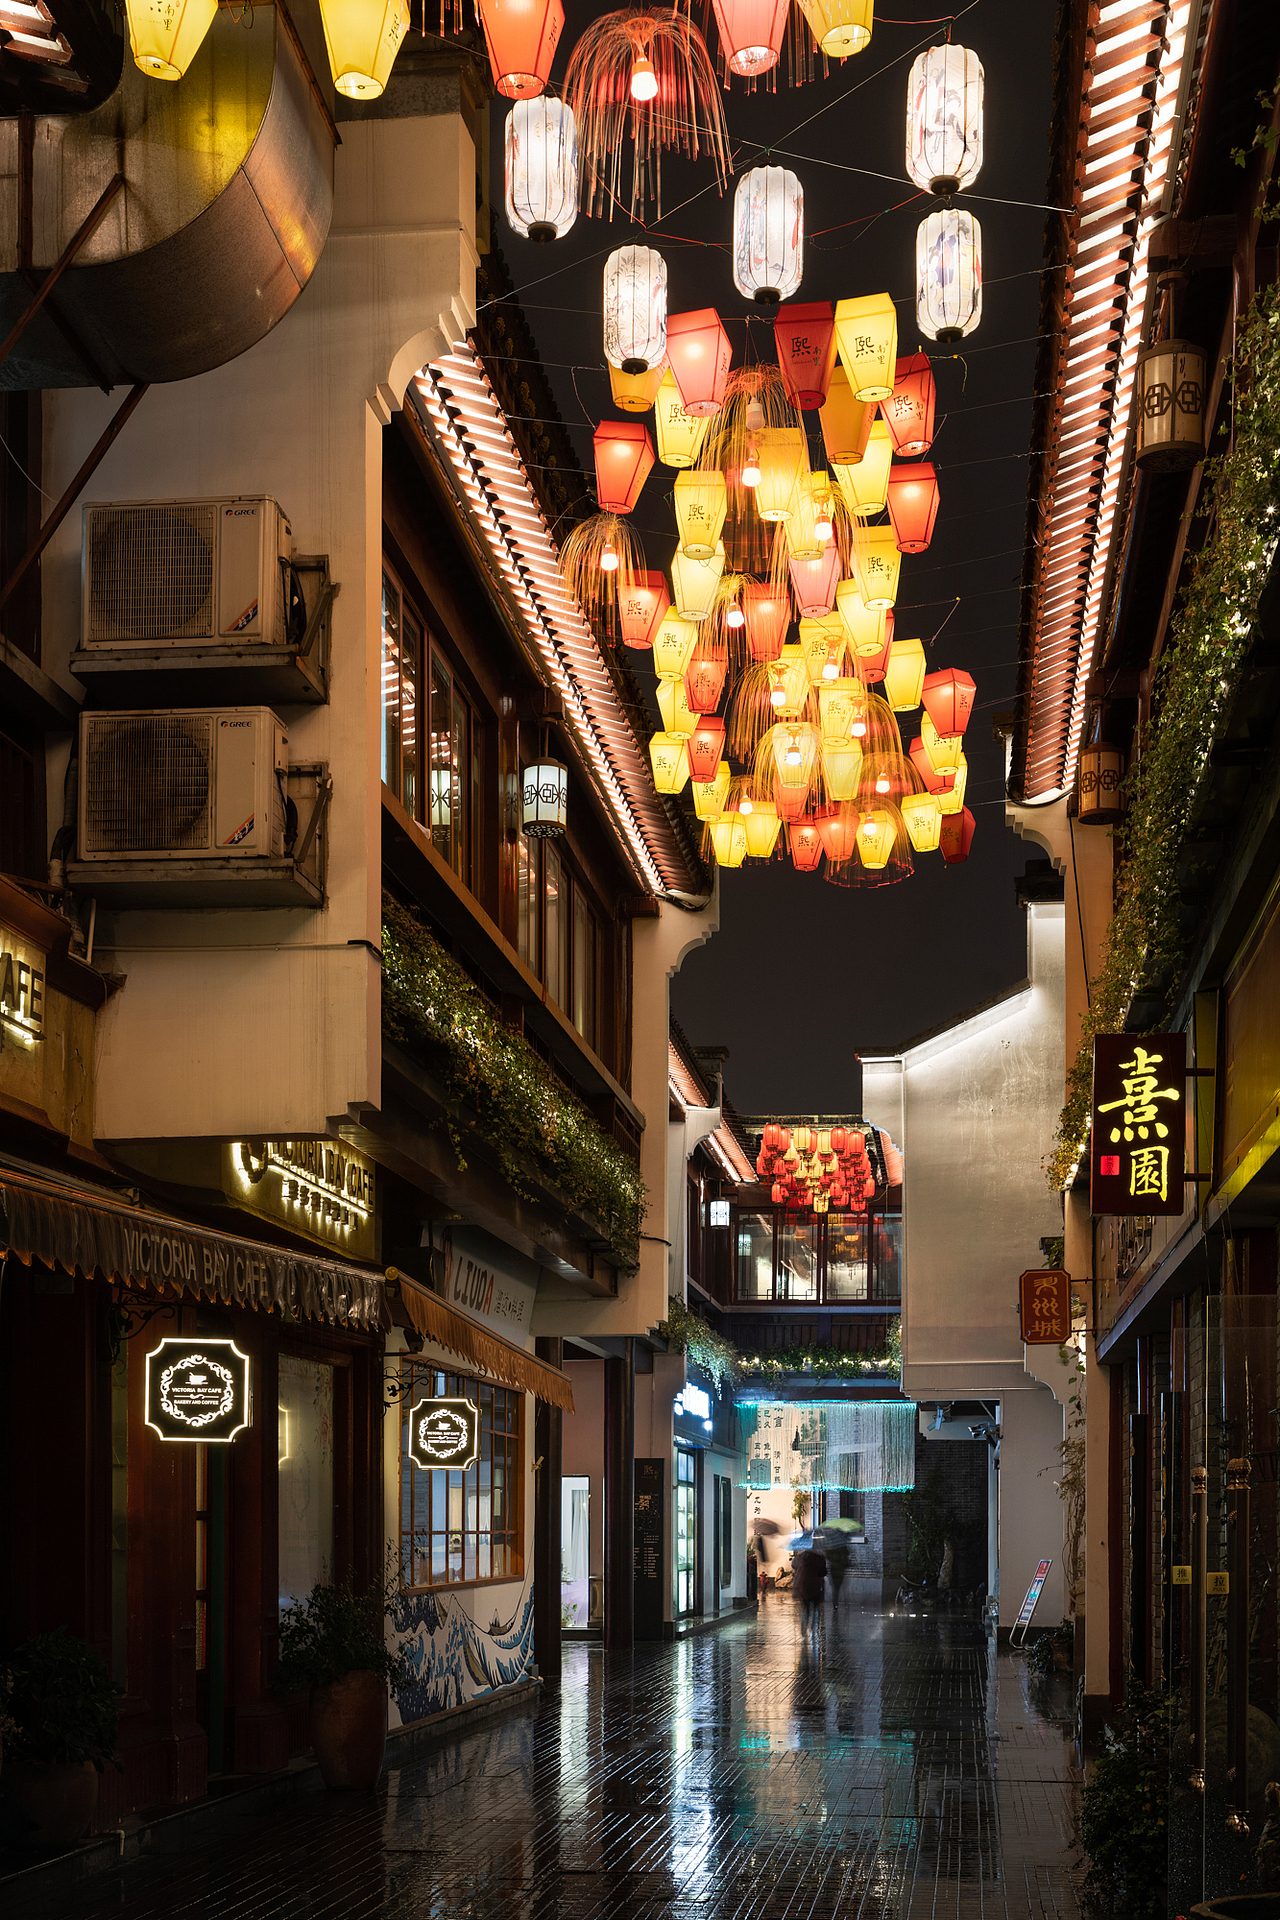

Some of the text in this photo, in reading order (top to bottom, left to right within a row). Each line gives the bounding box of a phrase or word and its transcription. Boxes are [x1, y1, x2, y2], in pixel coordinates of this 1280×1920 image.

[791, 336, 812, 358] 熙
[854, 335, 875, 358] 熙
[892, 395, 913, 417] 熙
[688, 504, 705, 521] 熙
[868, 556, 884, 574] 熙
[347, 1162, 374, 1206] CAFE
[124, 1228, 268, 1298] VICTORIA BAY CAFE
[1177, 1568, 1188, 1578] 推
[1214, 1576, 1225, 1587] 拉
